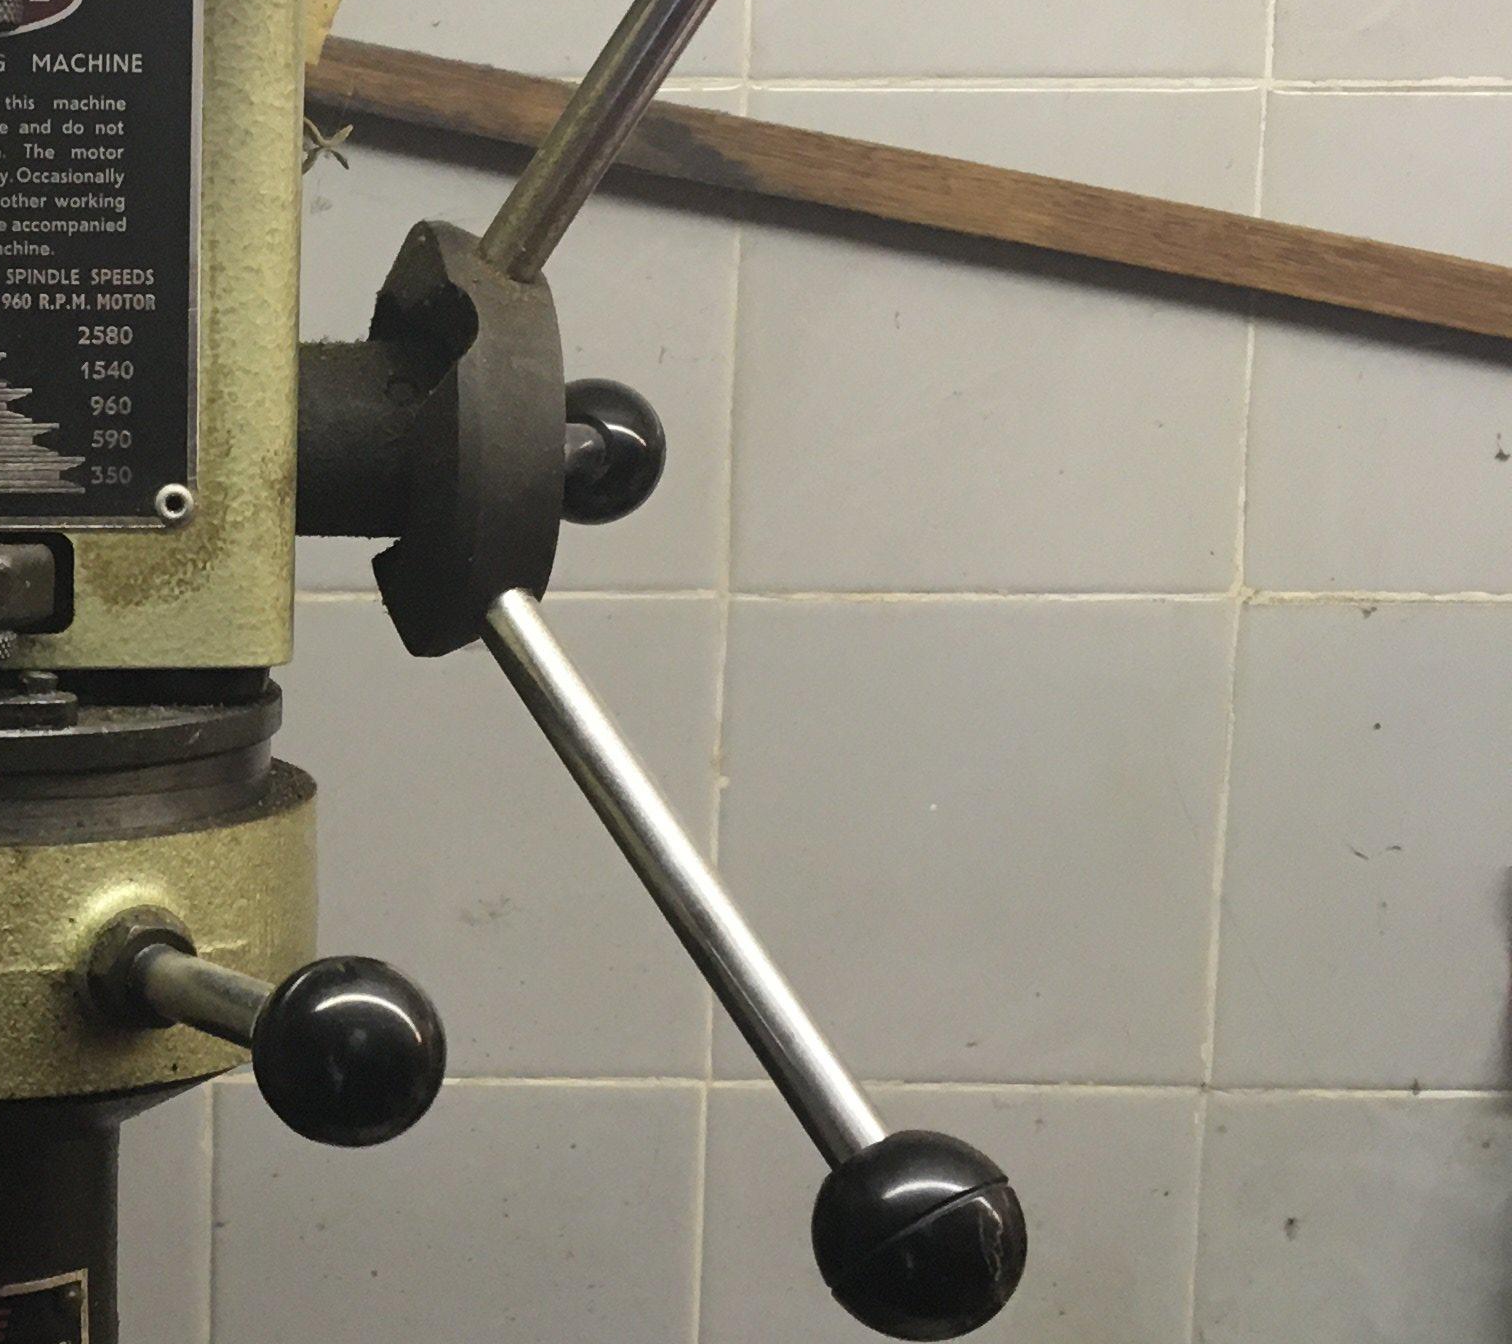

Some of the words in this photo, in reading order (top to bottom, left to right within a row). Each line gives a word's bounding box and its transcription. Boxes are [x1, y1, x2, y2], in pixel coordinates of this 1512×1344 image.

[32, 54, 143, 73] MACHINE
[5, 94, 35, 110] this
[53, 94, 126, 111] machine
[18, 119, 51, 135] and
[62, 119, 84, 135] do
[95, 120, 124, 135] not
[24, 143, 55, 160] The
[71, 144, 124, 160] motor
[16, 167, 125, 189] Occasionally
[0, 193, 47, 208] other
[54, 193, 126, 213] working
[12, 217, 127, 237] accompanied
[6, 268, 80, 285] SPINDLE
[90, 268, 155, 286] SPEEDS
[1, 293, 32, 310] 960
[39, 293, 91, 310] R.P.M.
[96, 293, 156, 311] MOTOR
[78, 326, 134, 345] 2580
[80, 361, 134, 380] 1540
[90, 396, 132, 415] 960
[91, 429, 132, 449] 590
[90, 466, 132, 485] 350
